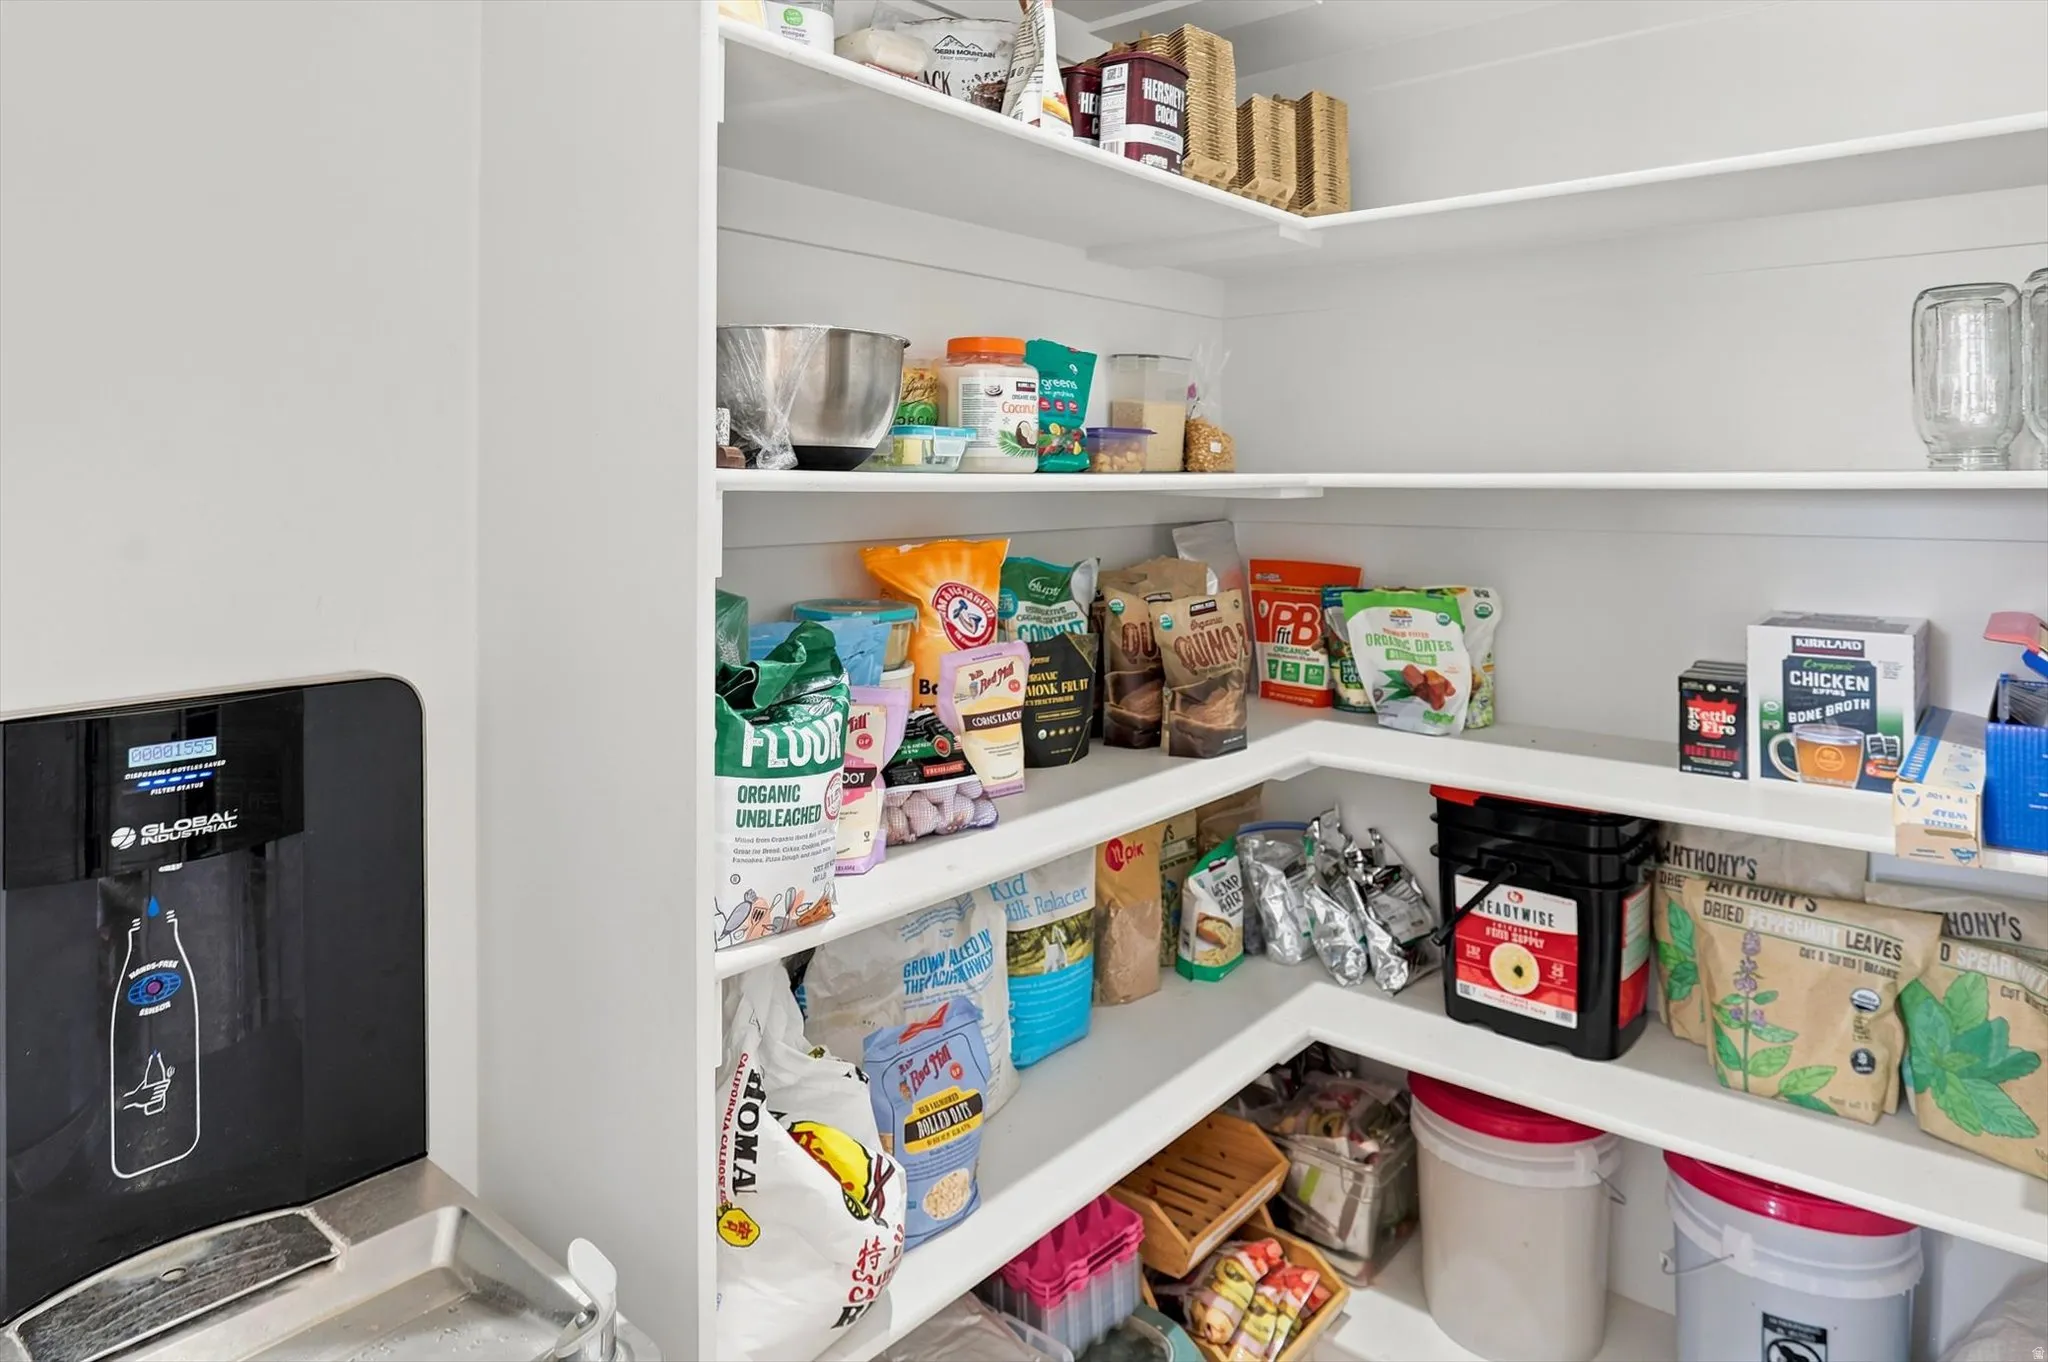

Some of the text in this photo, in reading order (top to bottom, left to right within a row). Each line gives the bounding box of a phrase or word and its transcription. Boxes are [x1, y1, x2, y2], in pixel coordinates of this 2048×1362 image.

[935, 48, 996, 59] DERN MOUNTAIN
[924, 70, 951, 96] ACK
[1155, 104, 1178, 129] COCOA
[1041, 379, 1078, 390] greens
[1270, 601, 1321, 647] PB
[1277, 627, 1291, 645] fit
[1365, 633, 1455, 652] ORGANIC DATES
[1795, 638, 1862, 651] KIRKLAND
[1174, 622, 1249, 676] QUINOA
[1273, 646, 1310, 657] ORGANIC
[979, 661, 1015, 696] Red Mill
[1028, 671, 1059, 682] RGANIC
[1061, 678, 1089, 694] FRUIT
[1790, 670, 1870, 692] CHICKEN
[971, 710, 1022, 727] CORNSTARCH
[1687, 707, 1736, 725] Kettle
[1788, 699, 1870, 723] BONE BROTH
[1687, 719, 1737, 736] & Fire
[131, 739, 215, 762] 00001555
[741, 711, 843, 768] FLOUR
[124, 760, 227, 780] DISPOSABLE BOTTLES SAVED
[151, 781, 204, 796] FILTER STATUS
[738, 784, 801, 804] ORGANIC
[141, 811, 238, 837] GLOBAL
[735, 804, 822, 828] UNBLEACHED
[141, 821, 238, 846] INDUSTRIAL
[989, 873, 1029, 901] Kid
[1660, 871, 1684, 889] DRIE
[1477, 900, 1556, 928] READYWISE
[1703, 899, 1744, 924] DRIED
[1749, 910, 1839, 946] PEPPERMINT
[1845, 930, 1903, 962] LEAVES
[1944, 911, 2022, 941] HONY'S
[1511, 931, 1545, 949] SUPPLY
[128, 960, 179, 980] HANDS-FREE
[139, 1001, 171, 1017] SENSOR
[909, 1043, 952, 1095] Red Mill
[721, 1053, 749, 1131] CALIFORNIA
[916, 1101, 973, 1139] ROLLED OATS
[731, 1068, 767, 1196] HOMA
